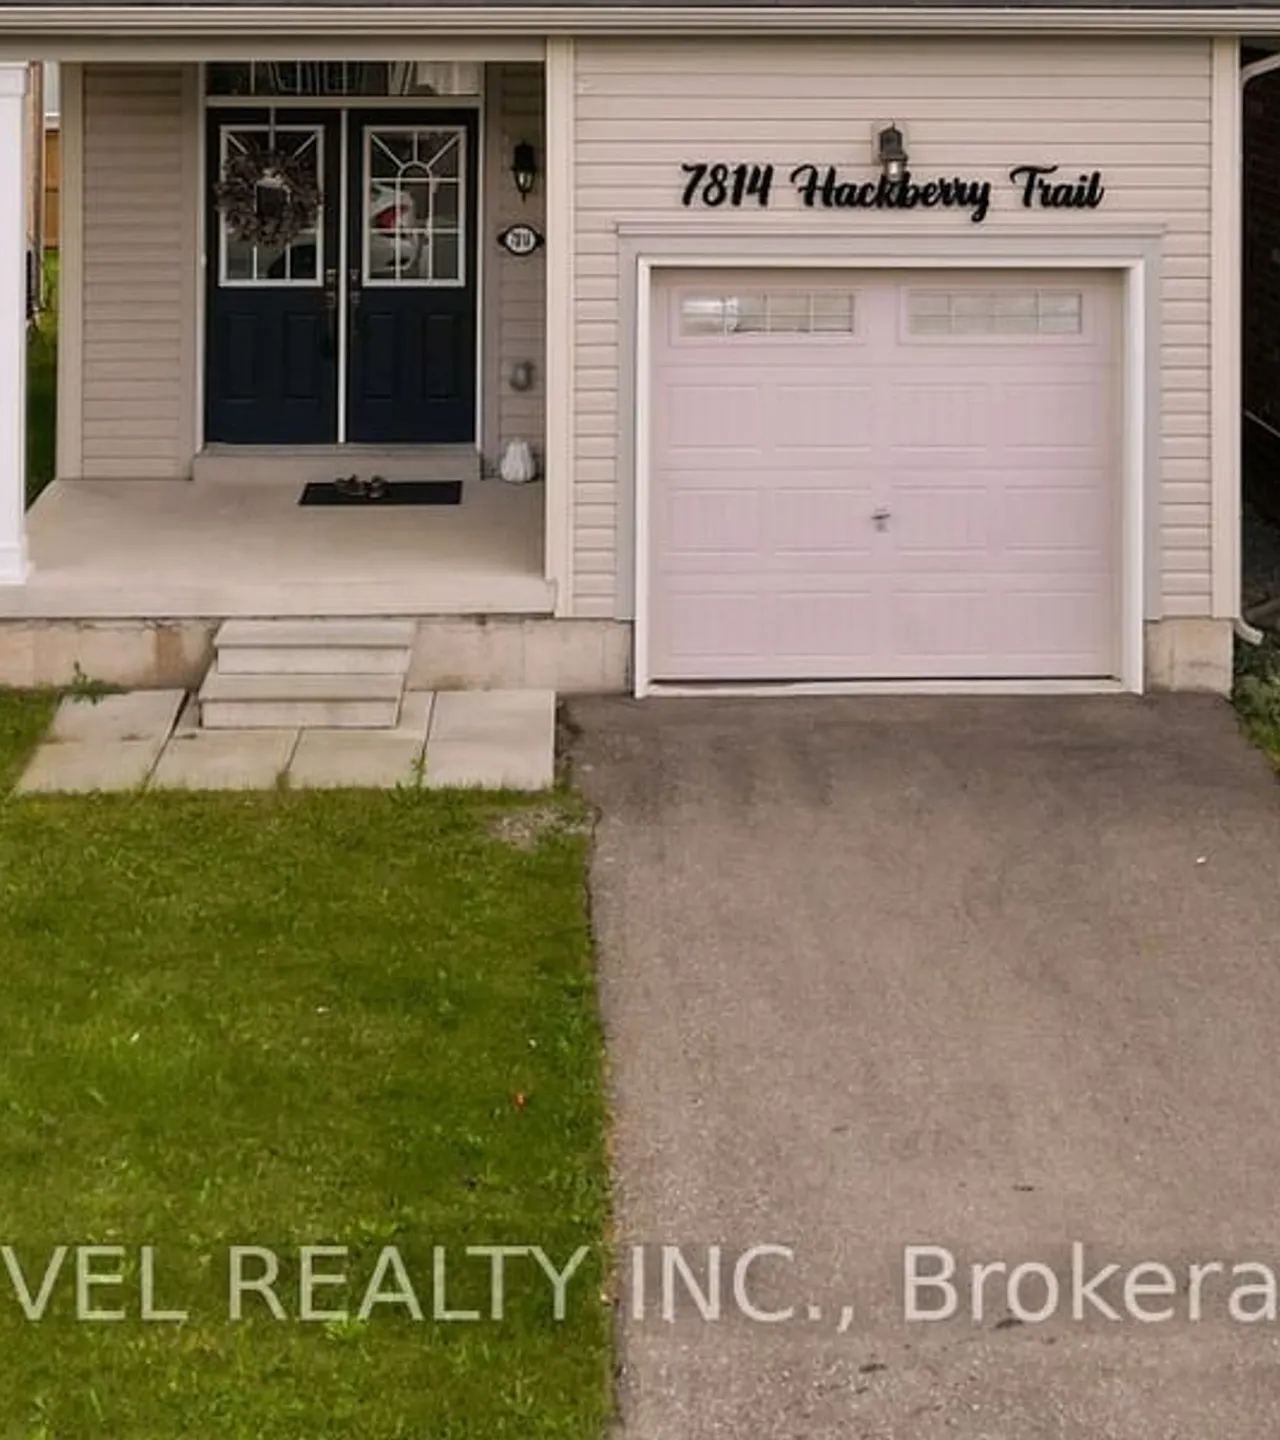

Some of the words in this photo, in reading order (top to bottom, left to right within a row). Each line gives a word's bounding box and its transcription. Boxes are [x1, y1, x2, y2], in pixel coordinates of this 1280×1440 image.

[681, 162, 774, 208] 7814
[789, 164, 992, 223] Hackberry
[1009, 164, 1106, 209] Trail
